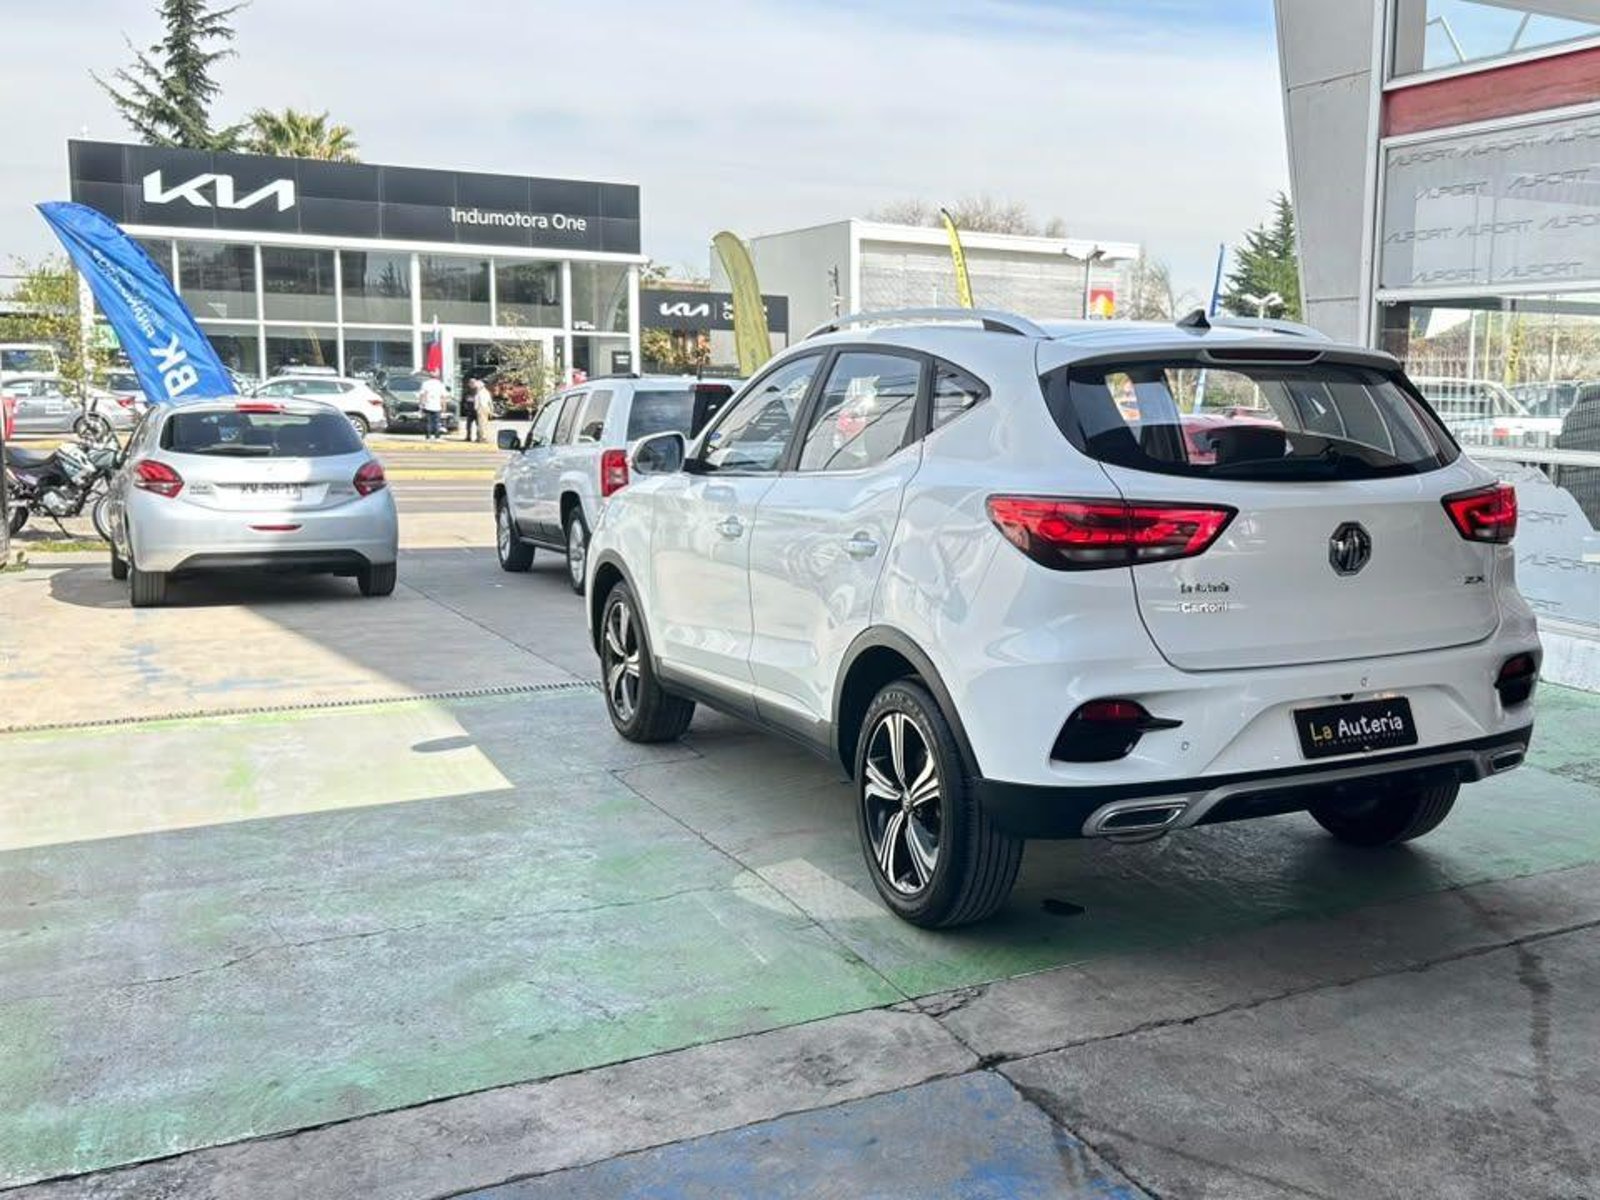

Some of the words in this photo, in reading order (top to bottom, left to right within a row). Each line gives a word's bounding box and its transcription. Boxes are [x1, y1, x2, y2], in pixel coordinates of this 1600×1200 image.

[143, 169, 295, 212] KIA
[450, 207, 548, 228] Indumotora
[552, 213, 587, 231] One
[660, 302, 709, 317] KIA
[150, 333, 199, 398] BK
[1310, 721, 1333, 741] La
[1338, 710, 1403, 738] Autería
